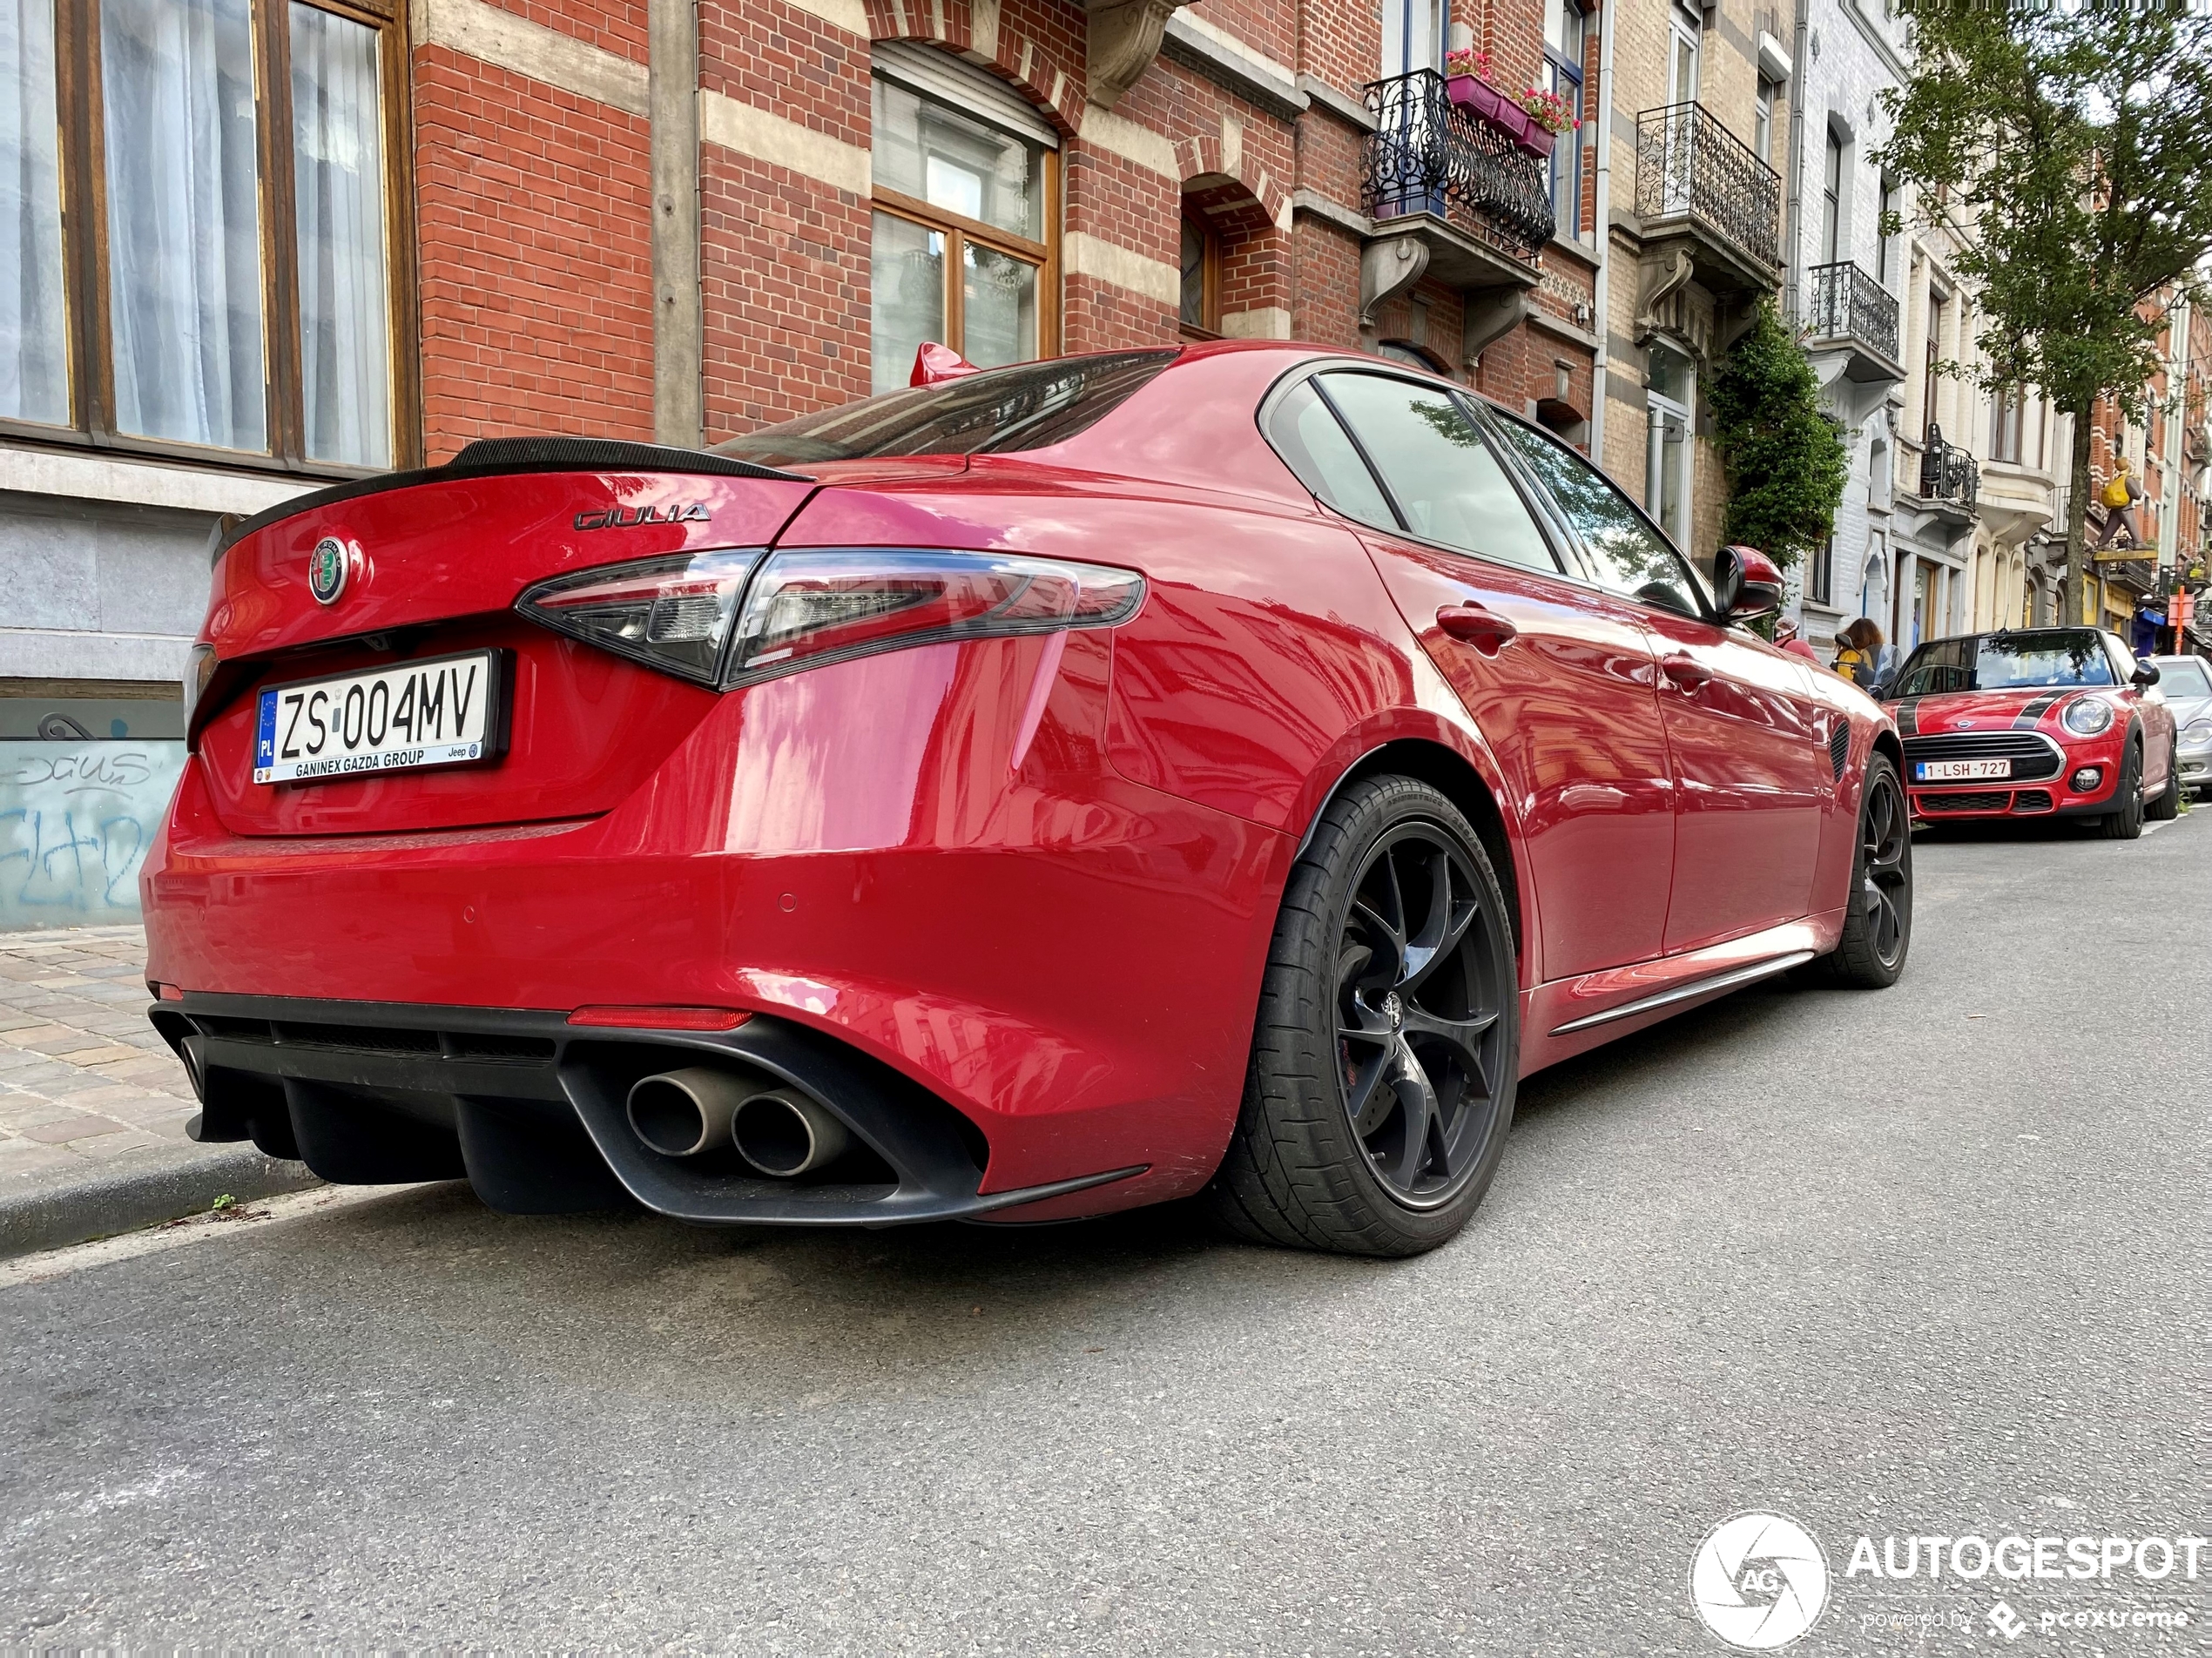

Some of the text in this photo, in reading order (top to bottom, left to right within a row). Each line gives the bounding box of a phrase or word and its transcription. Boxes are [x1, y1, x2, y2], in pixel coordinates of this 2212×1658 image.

[573, 503, 711, 530] GIULIA
[323, 541, 341, 568] ROMEO
[281, 664, 476, 758] ZS 004MV
[261, 739, 272, 758] PL
[448, 747, 466, 757] Jeep
[296, 750, 424, 777] GANINEX GAZDA GROUP
